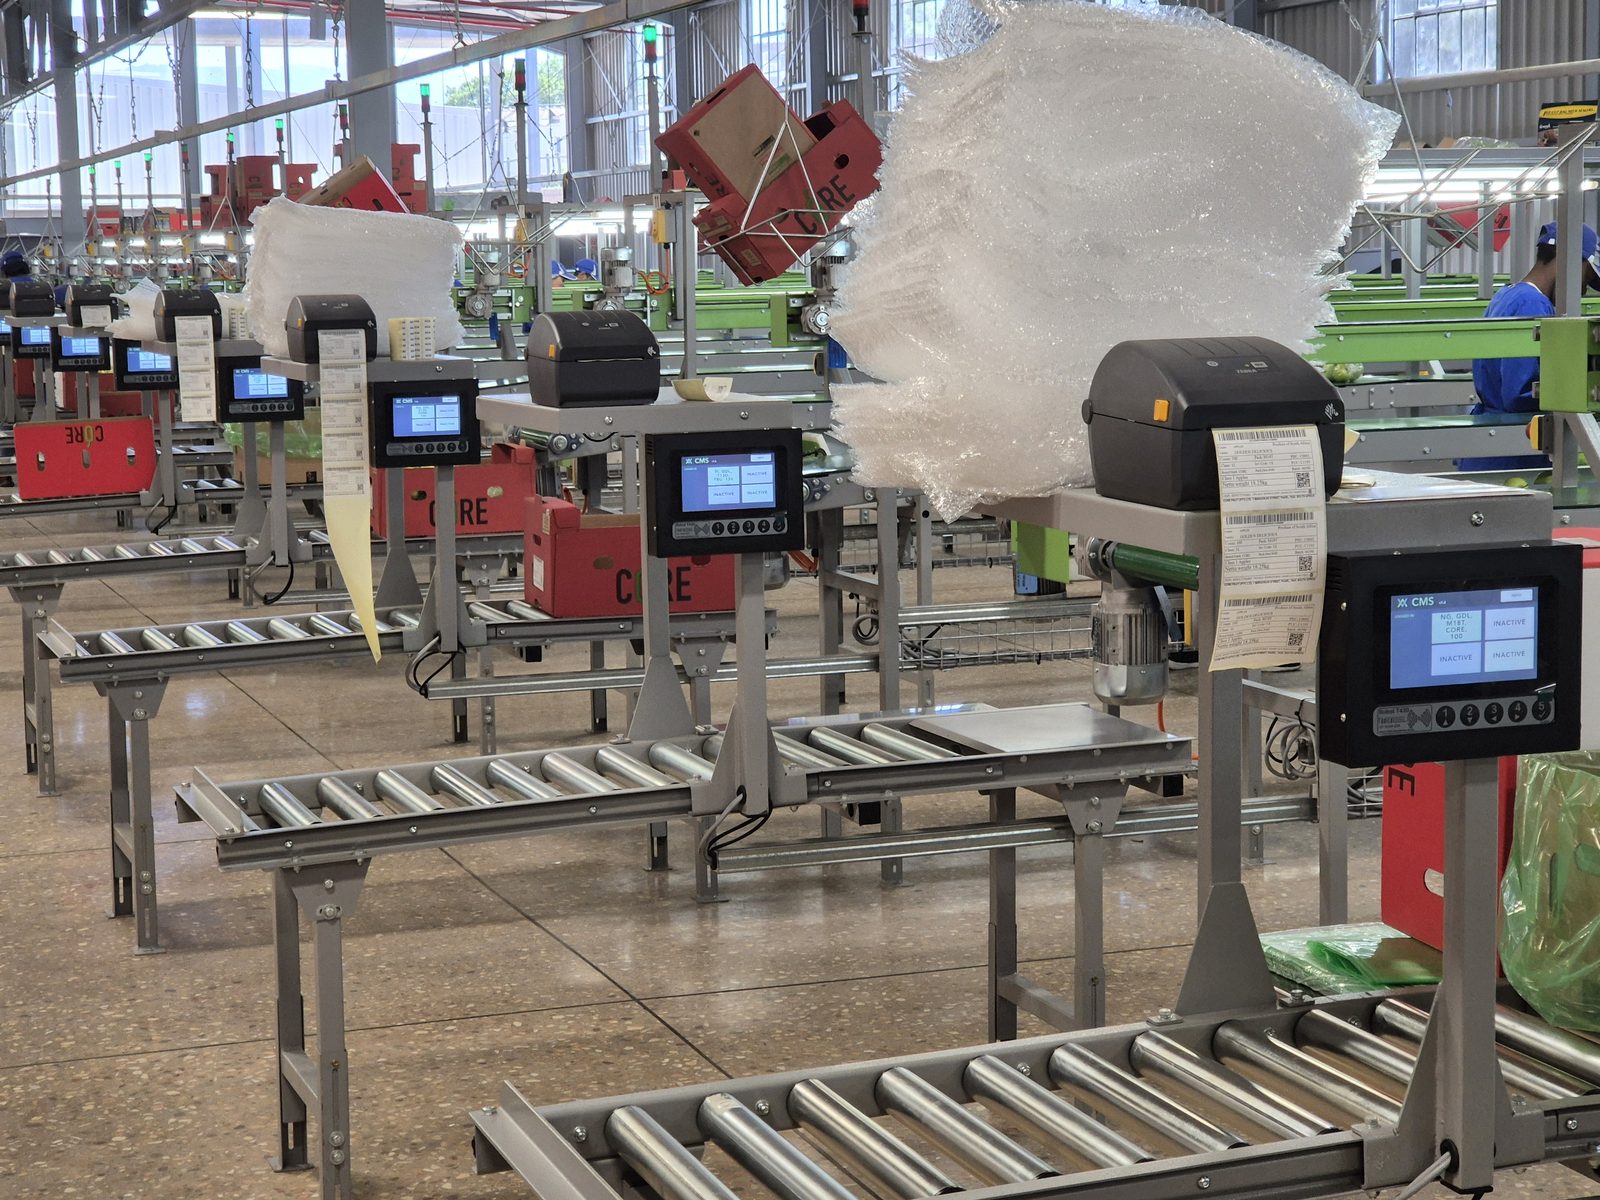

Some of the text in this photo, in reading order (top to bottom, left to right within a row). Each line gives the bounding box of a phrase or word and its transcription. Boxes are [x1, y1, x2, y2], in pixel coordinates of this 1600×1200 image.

[65, 425, 104, 445] CORE
[1412, 597, 1434, 607] CMS
[1493, 618, 1526, 627] INACTIVE
[1445, 626, 1468, 634] CORE,
[1439, 654, 1473, 663] INACTIVE
[1492, 650, 1526, 659] INACTIVE
[1491, 705, 1498, 714] 3
[1515, 702, 1522, 712] 4
[1538, 701, 1545, 710] 5
[1442, 708, 1448, 718] 1
[1466, 706, 1473, 716] 2
